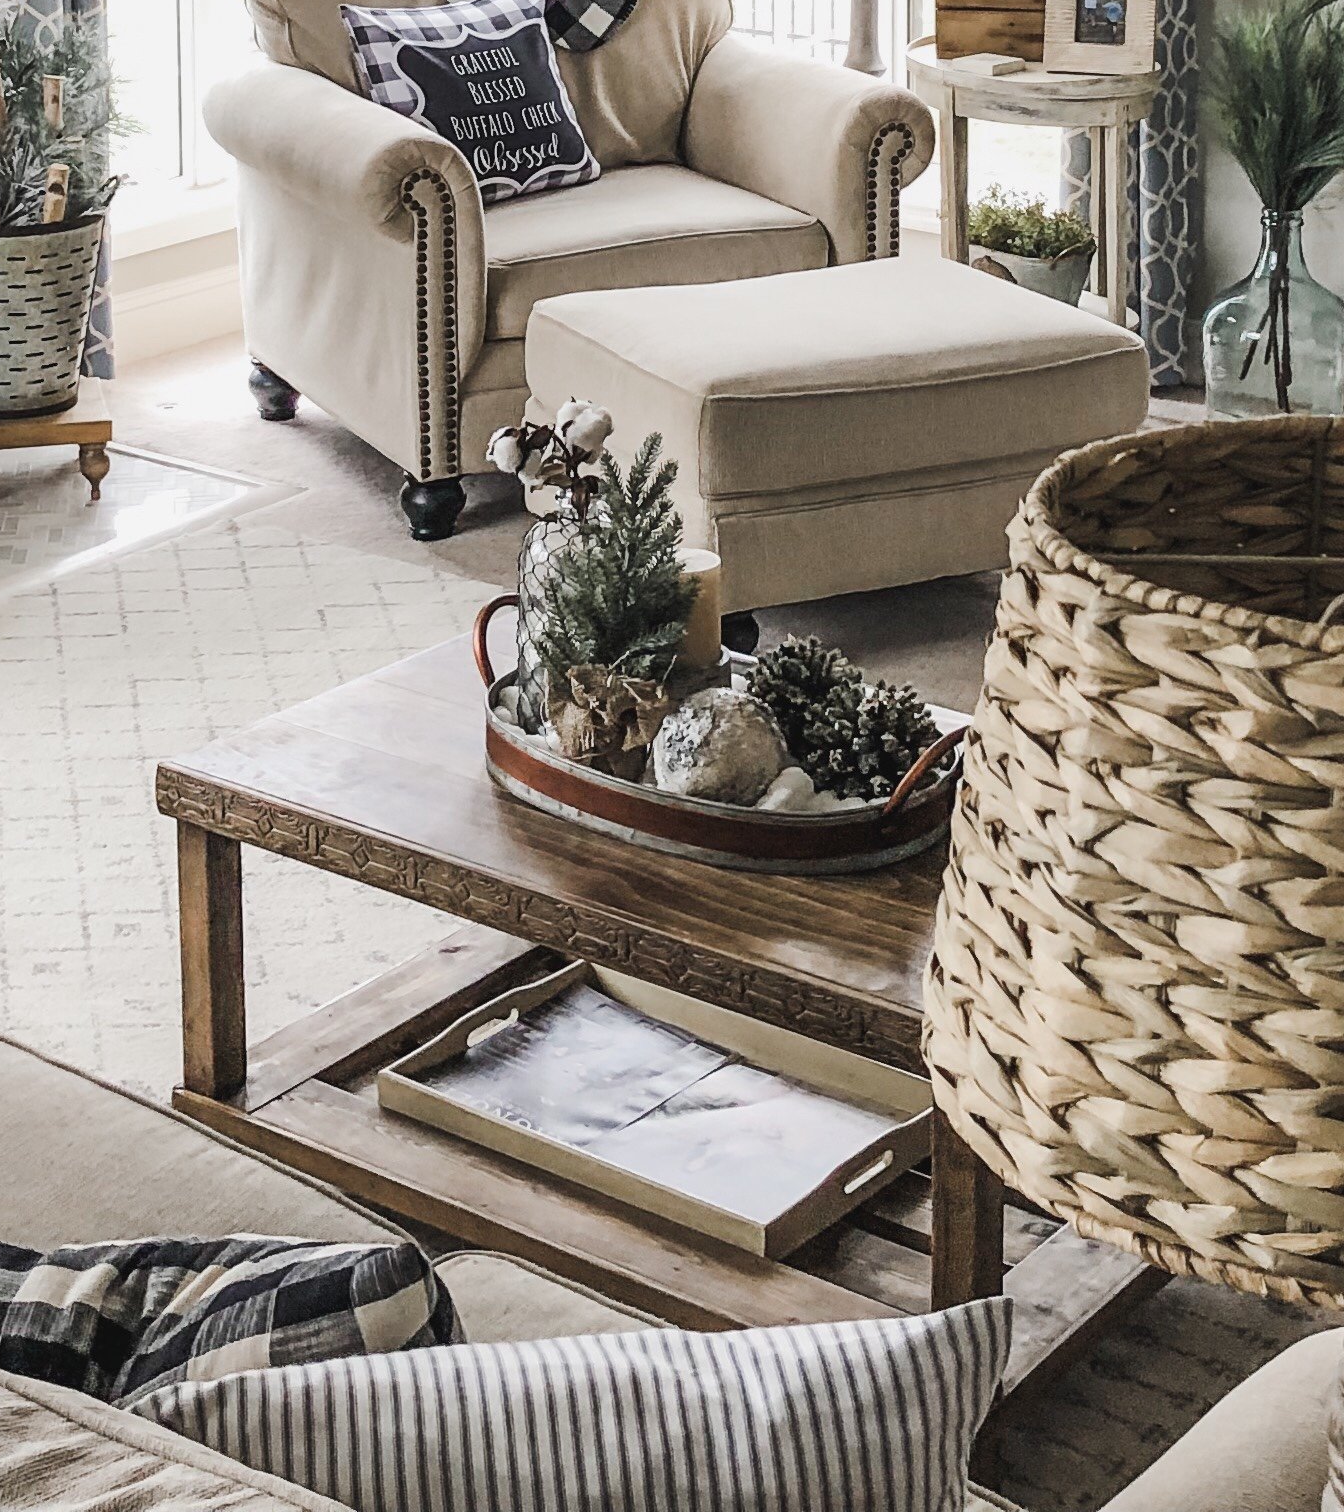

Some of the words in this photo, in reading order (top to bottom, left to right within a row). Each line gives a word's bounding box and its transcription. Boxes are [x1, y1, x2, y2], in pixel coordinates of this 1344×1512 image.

[451, 46, 519, 76] GRATEFUL
[467, 76, 526, 105] BLESSED
[450, 111, 515, 141] BUFFALO
[521, 101, 562, 131] CHECK
[474, 132, 559, 175] Obsessed
